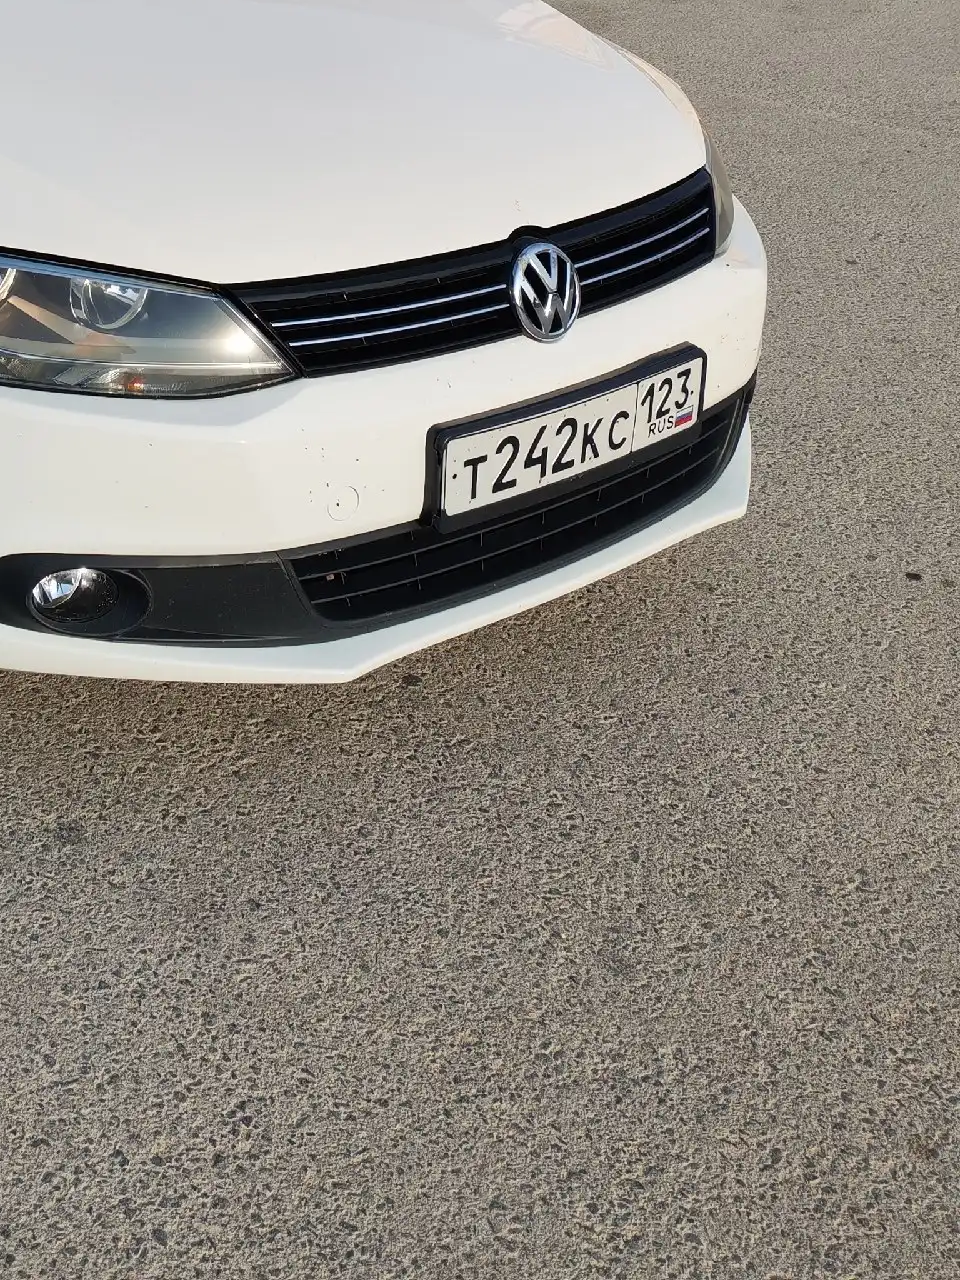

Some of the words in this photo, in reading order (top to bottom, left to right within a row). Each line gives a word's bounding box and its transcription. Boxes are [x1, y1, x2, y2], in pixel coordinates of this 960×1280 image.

[513, 243, 579, 341] VW
[641, 368, 692, 424] 123
[647, 415, 674, 438] RUS
